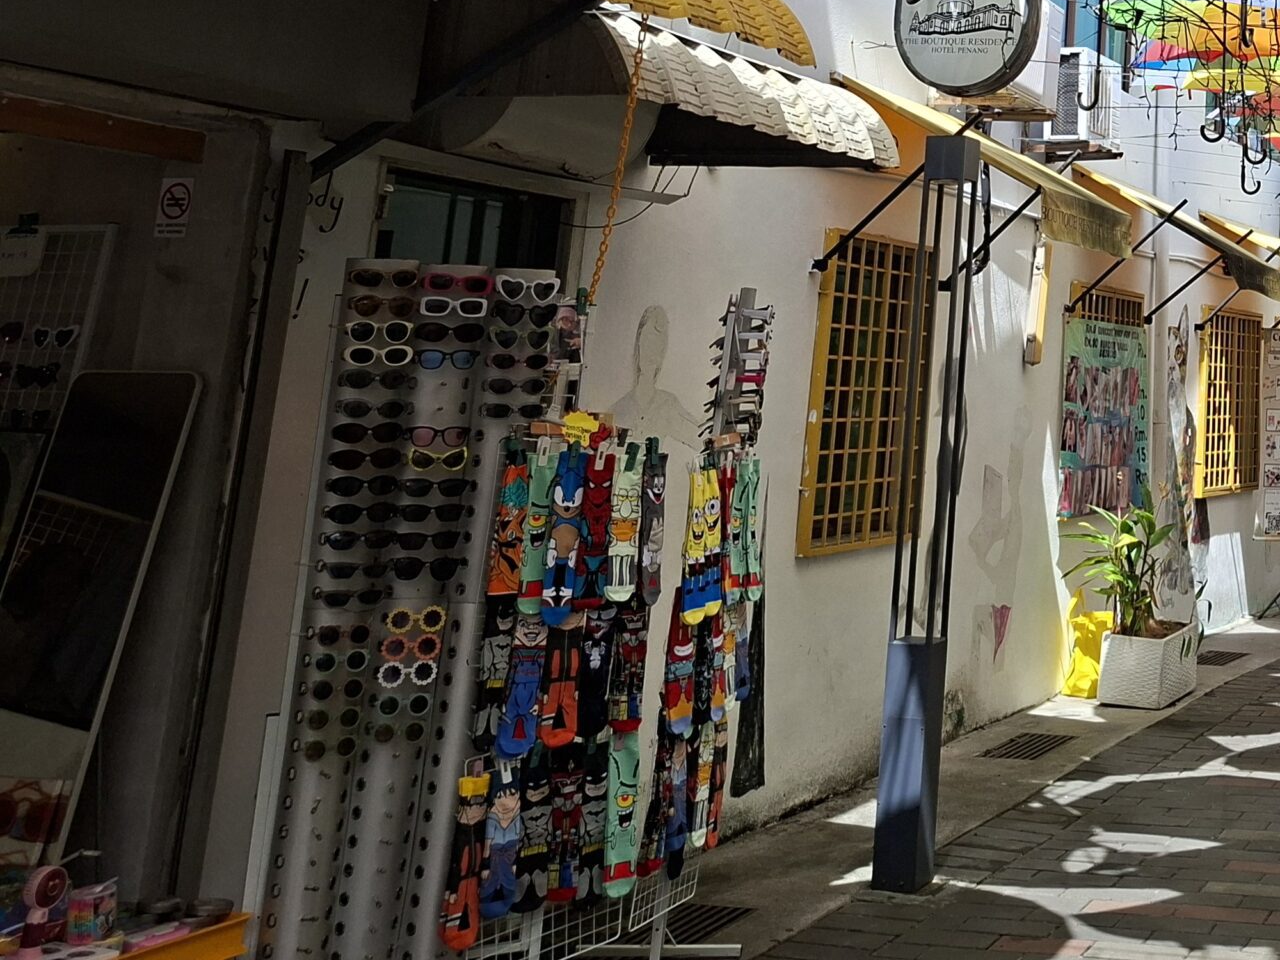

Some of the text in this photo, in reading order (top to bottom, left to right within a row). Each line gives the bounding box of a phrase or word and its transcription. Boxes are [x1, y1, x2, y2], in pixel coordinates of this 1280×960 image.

[904, 37, 1016, 46] THE BOUTIQUE RESIDENCE
[1136, 446, 1147, 463] 15
